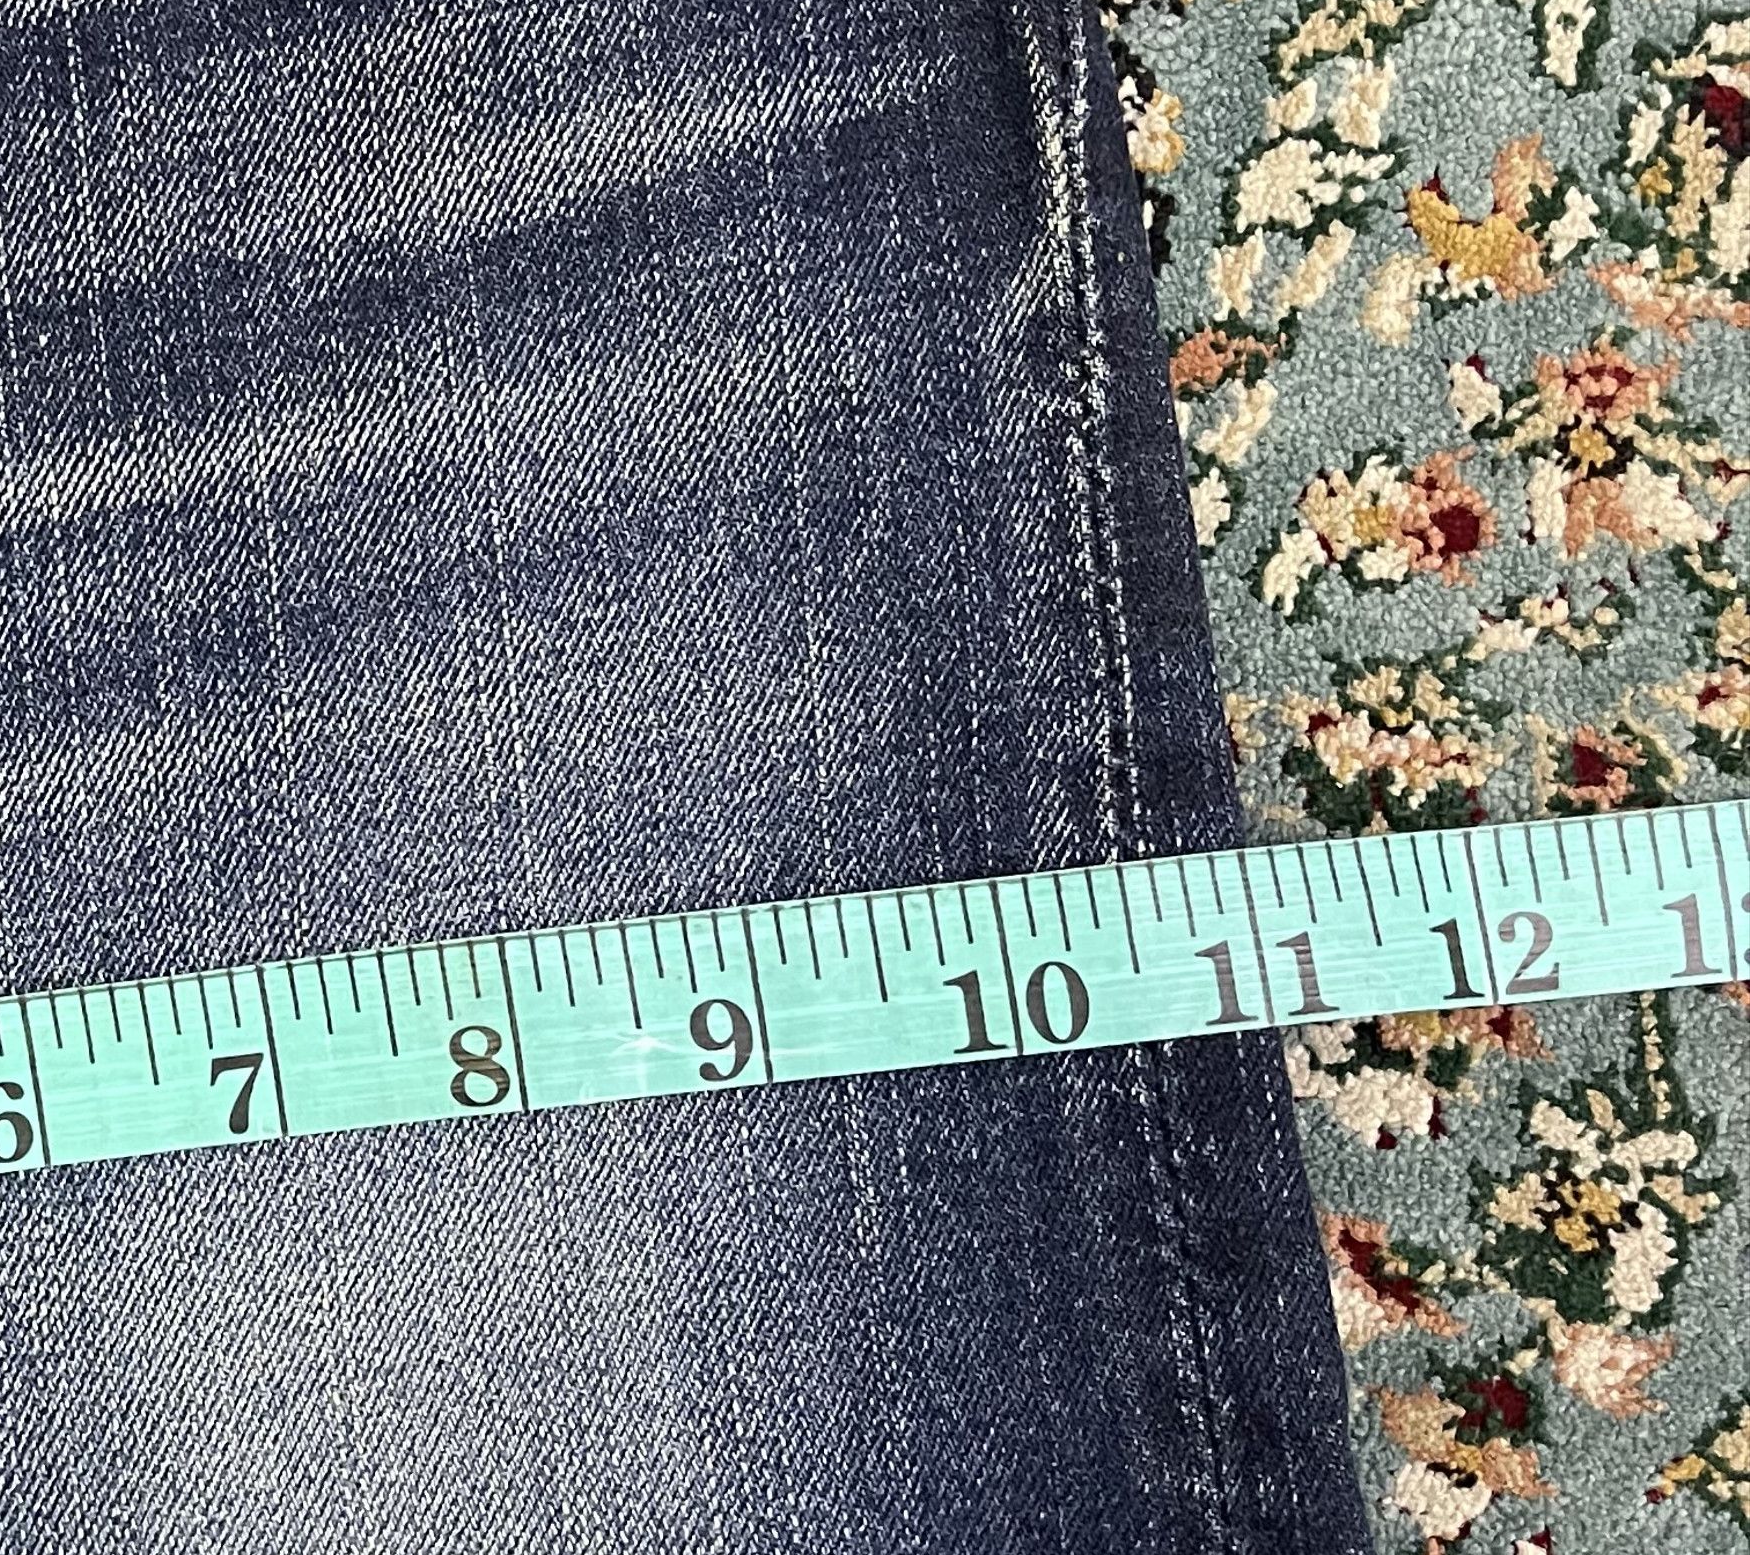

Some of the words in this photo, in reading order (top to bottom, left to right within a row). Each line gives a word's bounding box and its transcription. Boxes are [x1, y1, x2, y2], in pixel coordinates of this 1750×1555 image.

[210, 1052, 265, 1134] 7
[449, 1026, 511, 1107] 8
[689, 998, 753, 1082] 9
[943, 961, 1091, 1055] 10
[1194, 931, 1340, 1026] 11
[1430, 911, 1560, 1001] 12
[1662, 892, 1750, 979] 1
